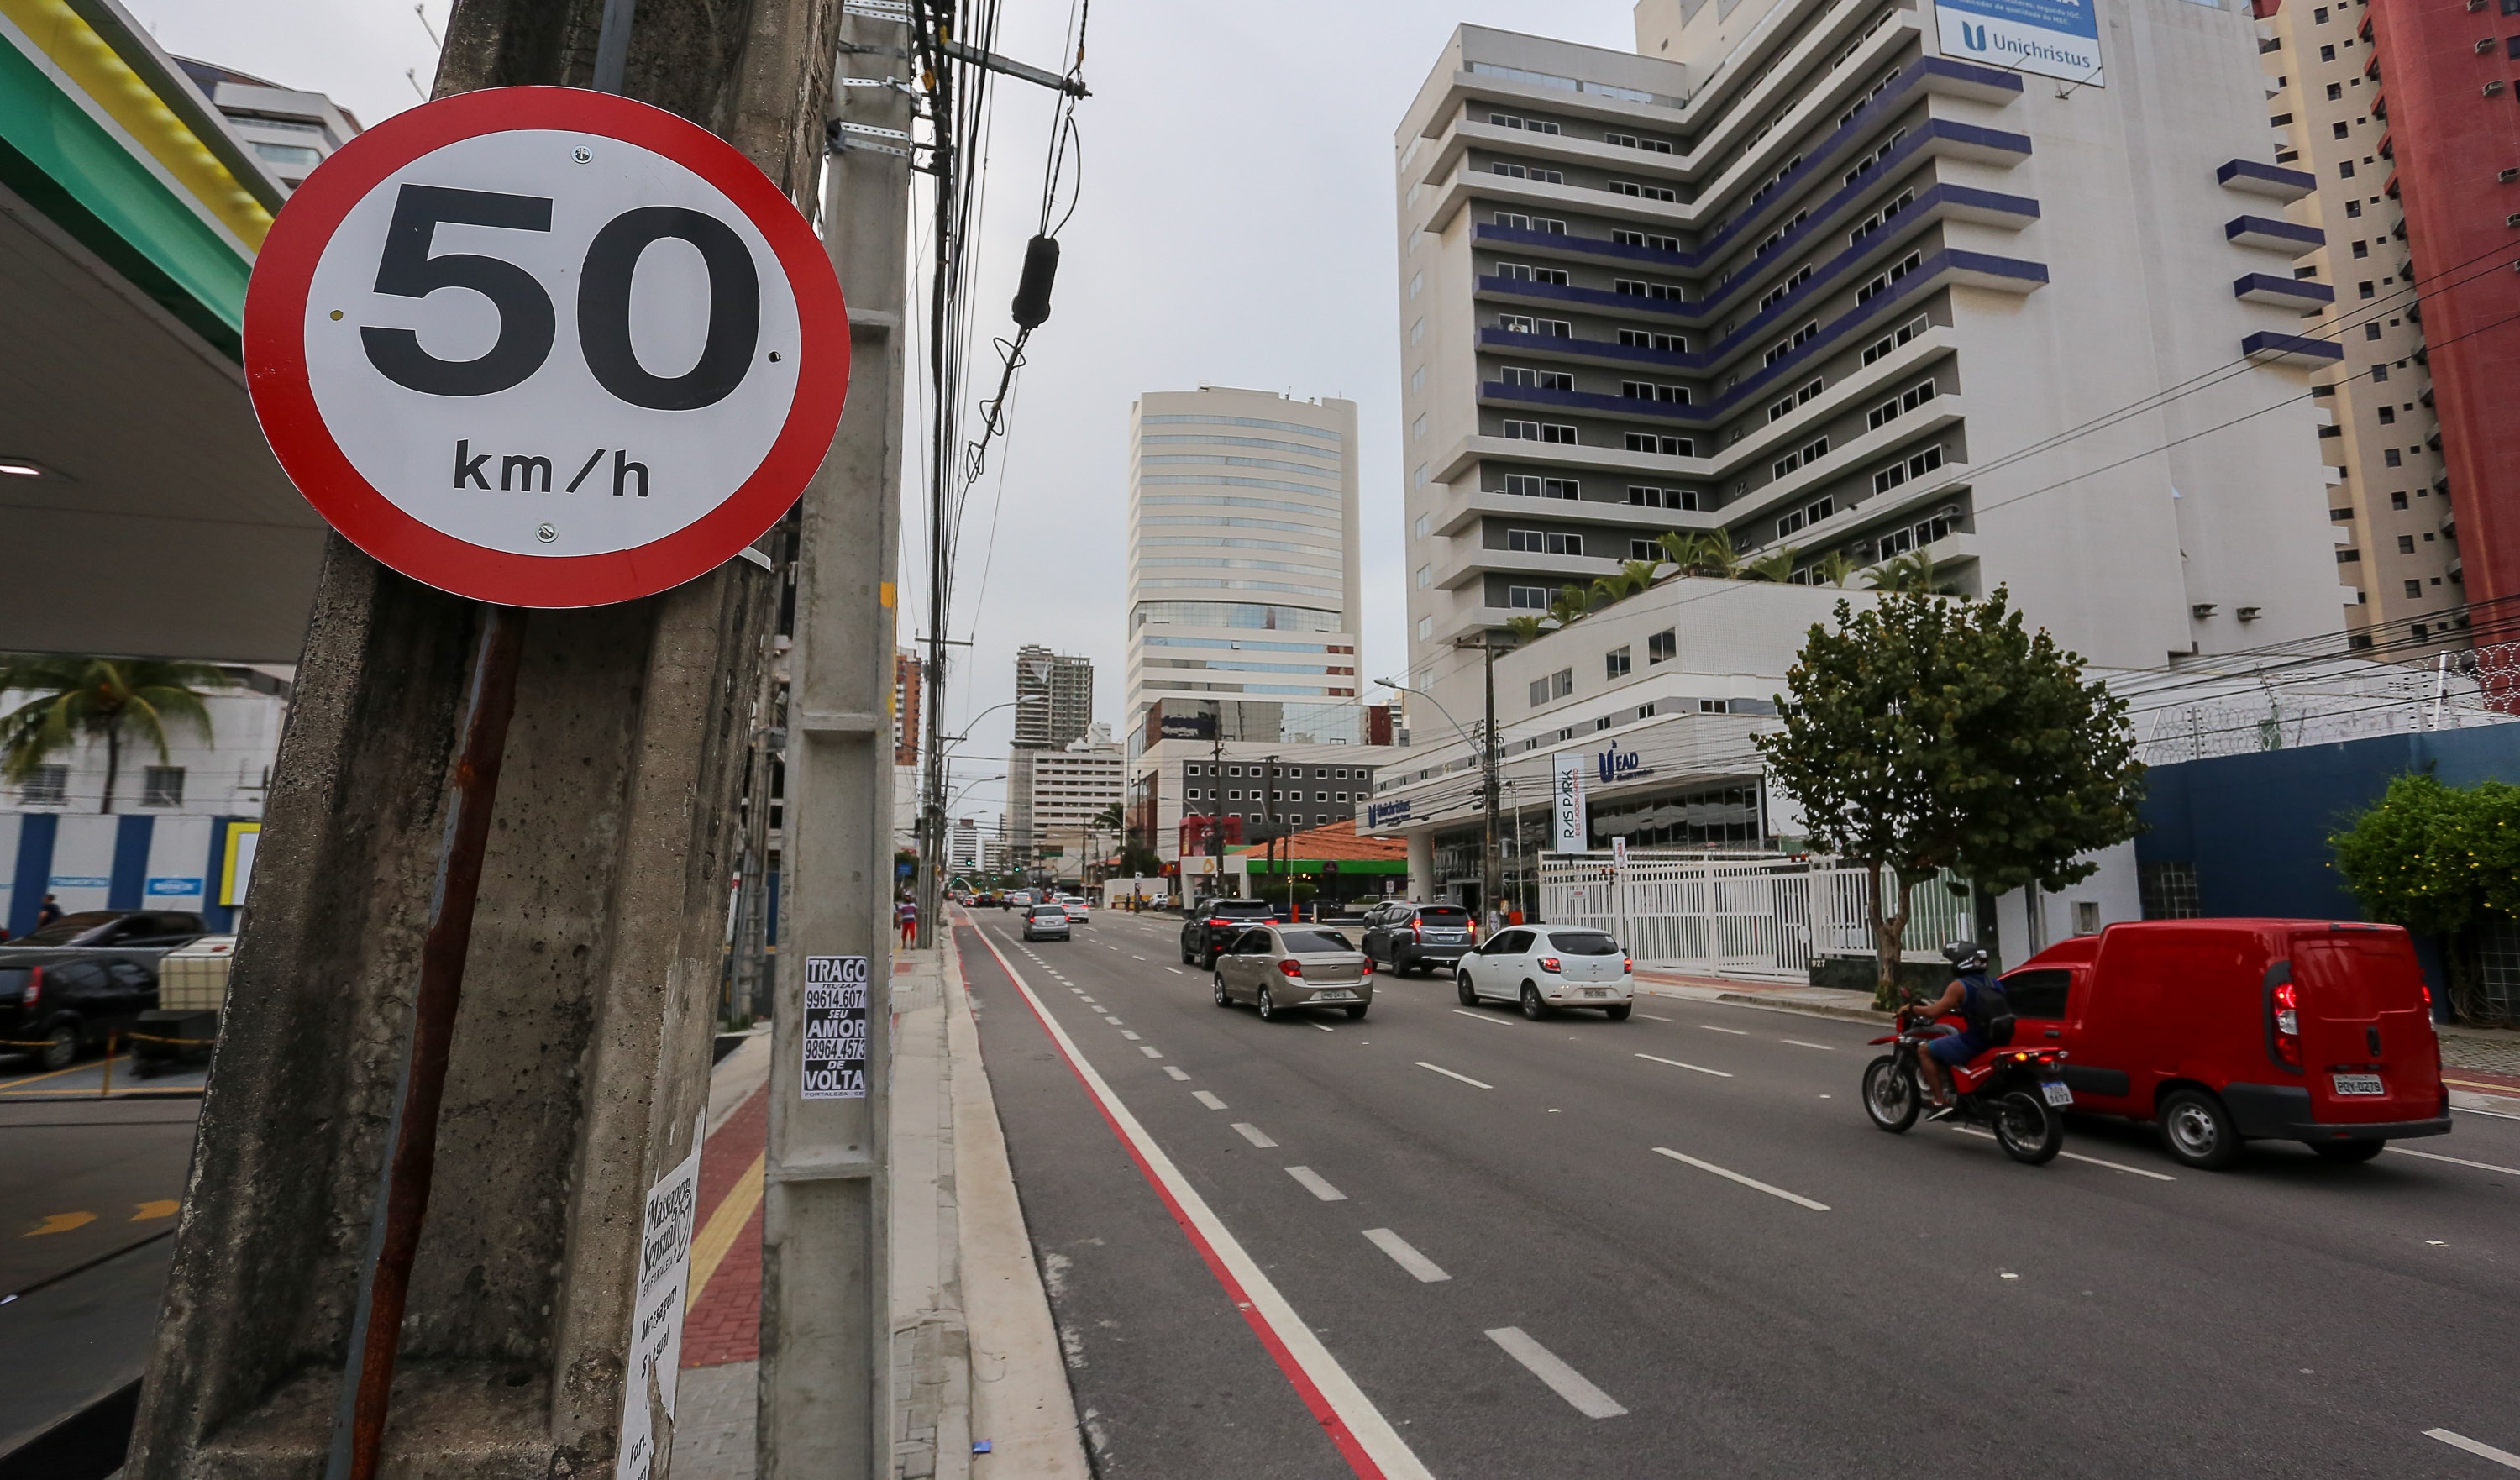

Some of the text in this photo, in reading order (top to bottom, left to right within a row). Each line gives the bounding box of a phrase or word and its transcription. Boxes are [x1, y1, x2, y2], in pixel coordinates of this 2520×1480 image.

[1993, 33, 2091, 69] Unichristus
[360, 183, 761, 412] 50
[453, 438, 651, 498] km/h
[1616, 752, 1639, 771] EAD
[1561, 769, 1574, 839] RAS PARK
[809, 959, 866, 982] TRAGO
[807, 1019, 865, 1038] AMOR
[827, 1010, 849, 1019] SEU
[805, 1069, 865, 1090] VOLTA
[827, 1060, 846, 1070] DE
[644, 1176, 691, 1241] Massagem
[641, 1215, 677, 1284] Sensual
[641, 1323, 670, 1379] Ssual
